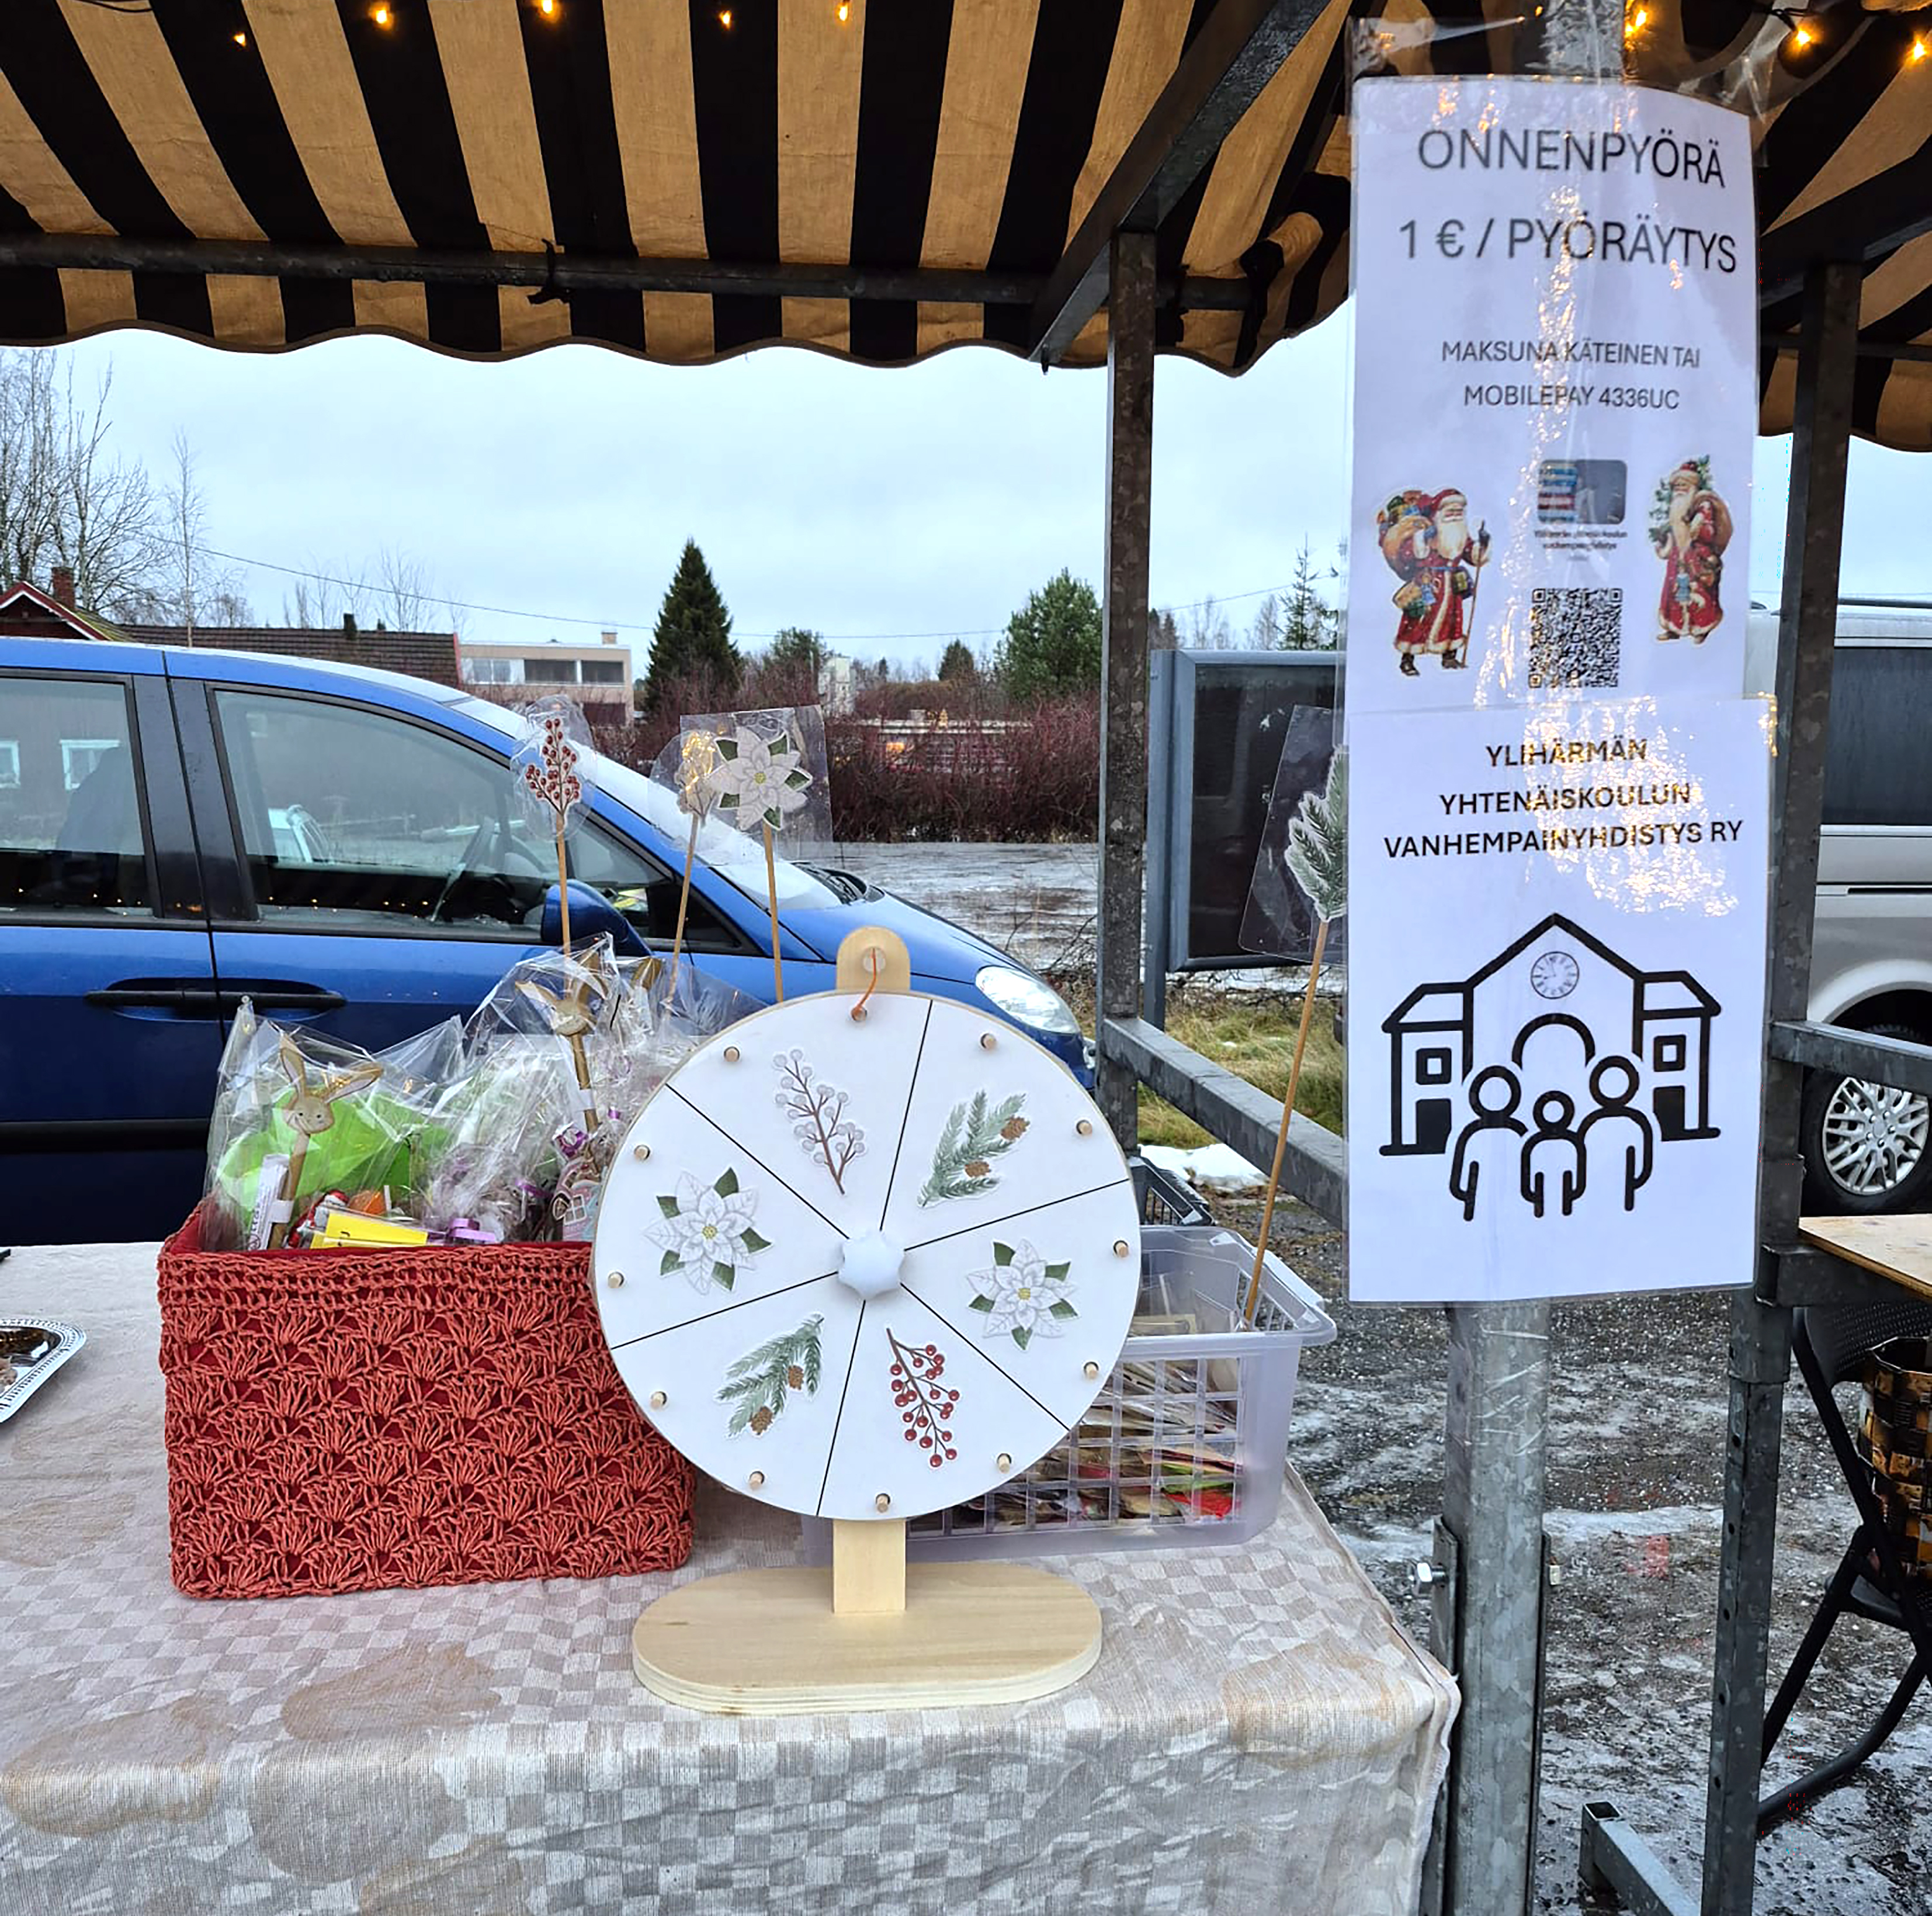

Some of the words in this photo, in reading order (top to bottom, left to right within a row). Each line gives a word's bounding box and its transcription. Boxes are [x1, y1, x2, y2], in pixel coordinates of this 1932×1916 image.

[1418, 128, 1725, 188] ONNENPYÖRÄ
[1400, 219, 1416, 259] 1
[1435, 219, 1465, 259] €
[1476, 218, 1494, 259] /
[1508, 212, 1736, 273] PYÖRÄYTYS
[1442, 341, 1559, 362] MAKSUNA
[1565, 338, 1670, 366] KÄTEINEN
[1673, 347, 1701, 368] TAI
[1464, 385, 1594, 407] MOBILEPAY
[1598, 386, 1680, 409] 4336UC
[1486, 735, 1647, 767] YLIHÄRMÄN
[1440, 783, 1691, 816] YHTENÄISKOULUN
[1384, 822, 1702, 858] VANHEMPAINYHDISTYS
[1710, 820, 1744, 842] RY
